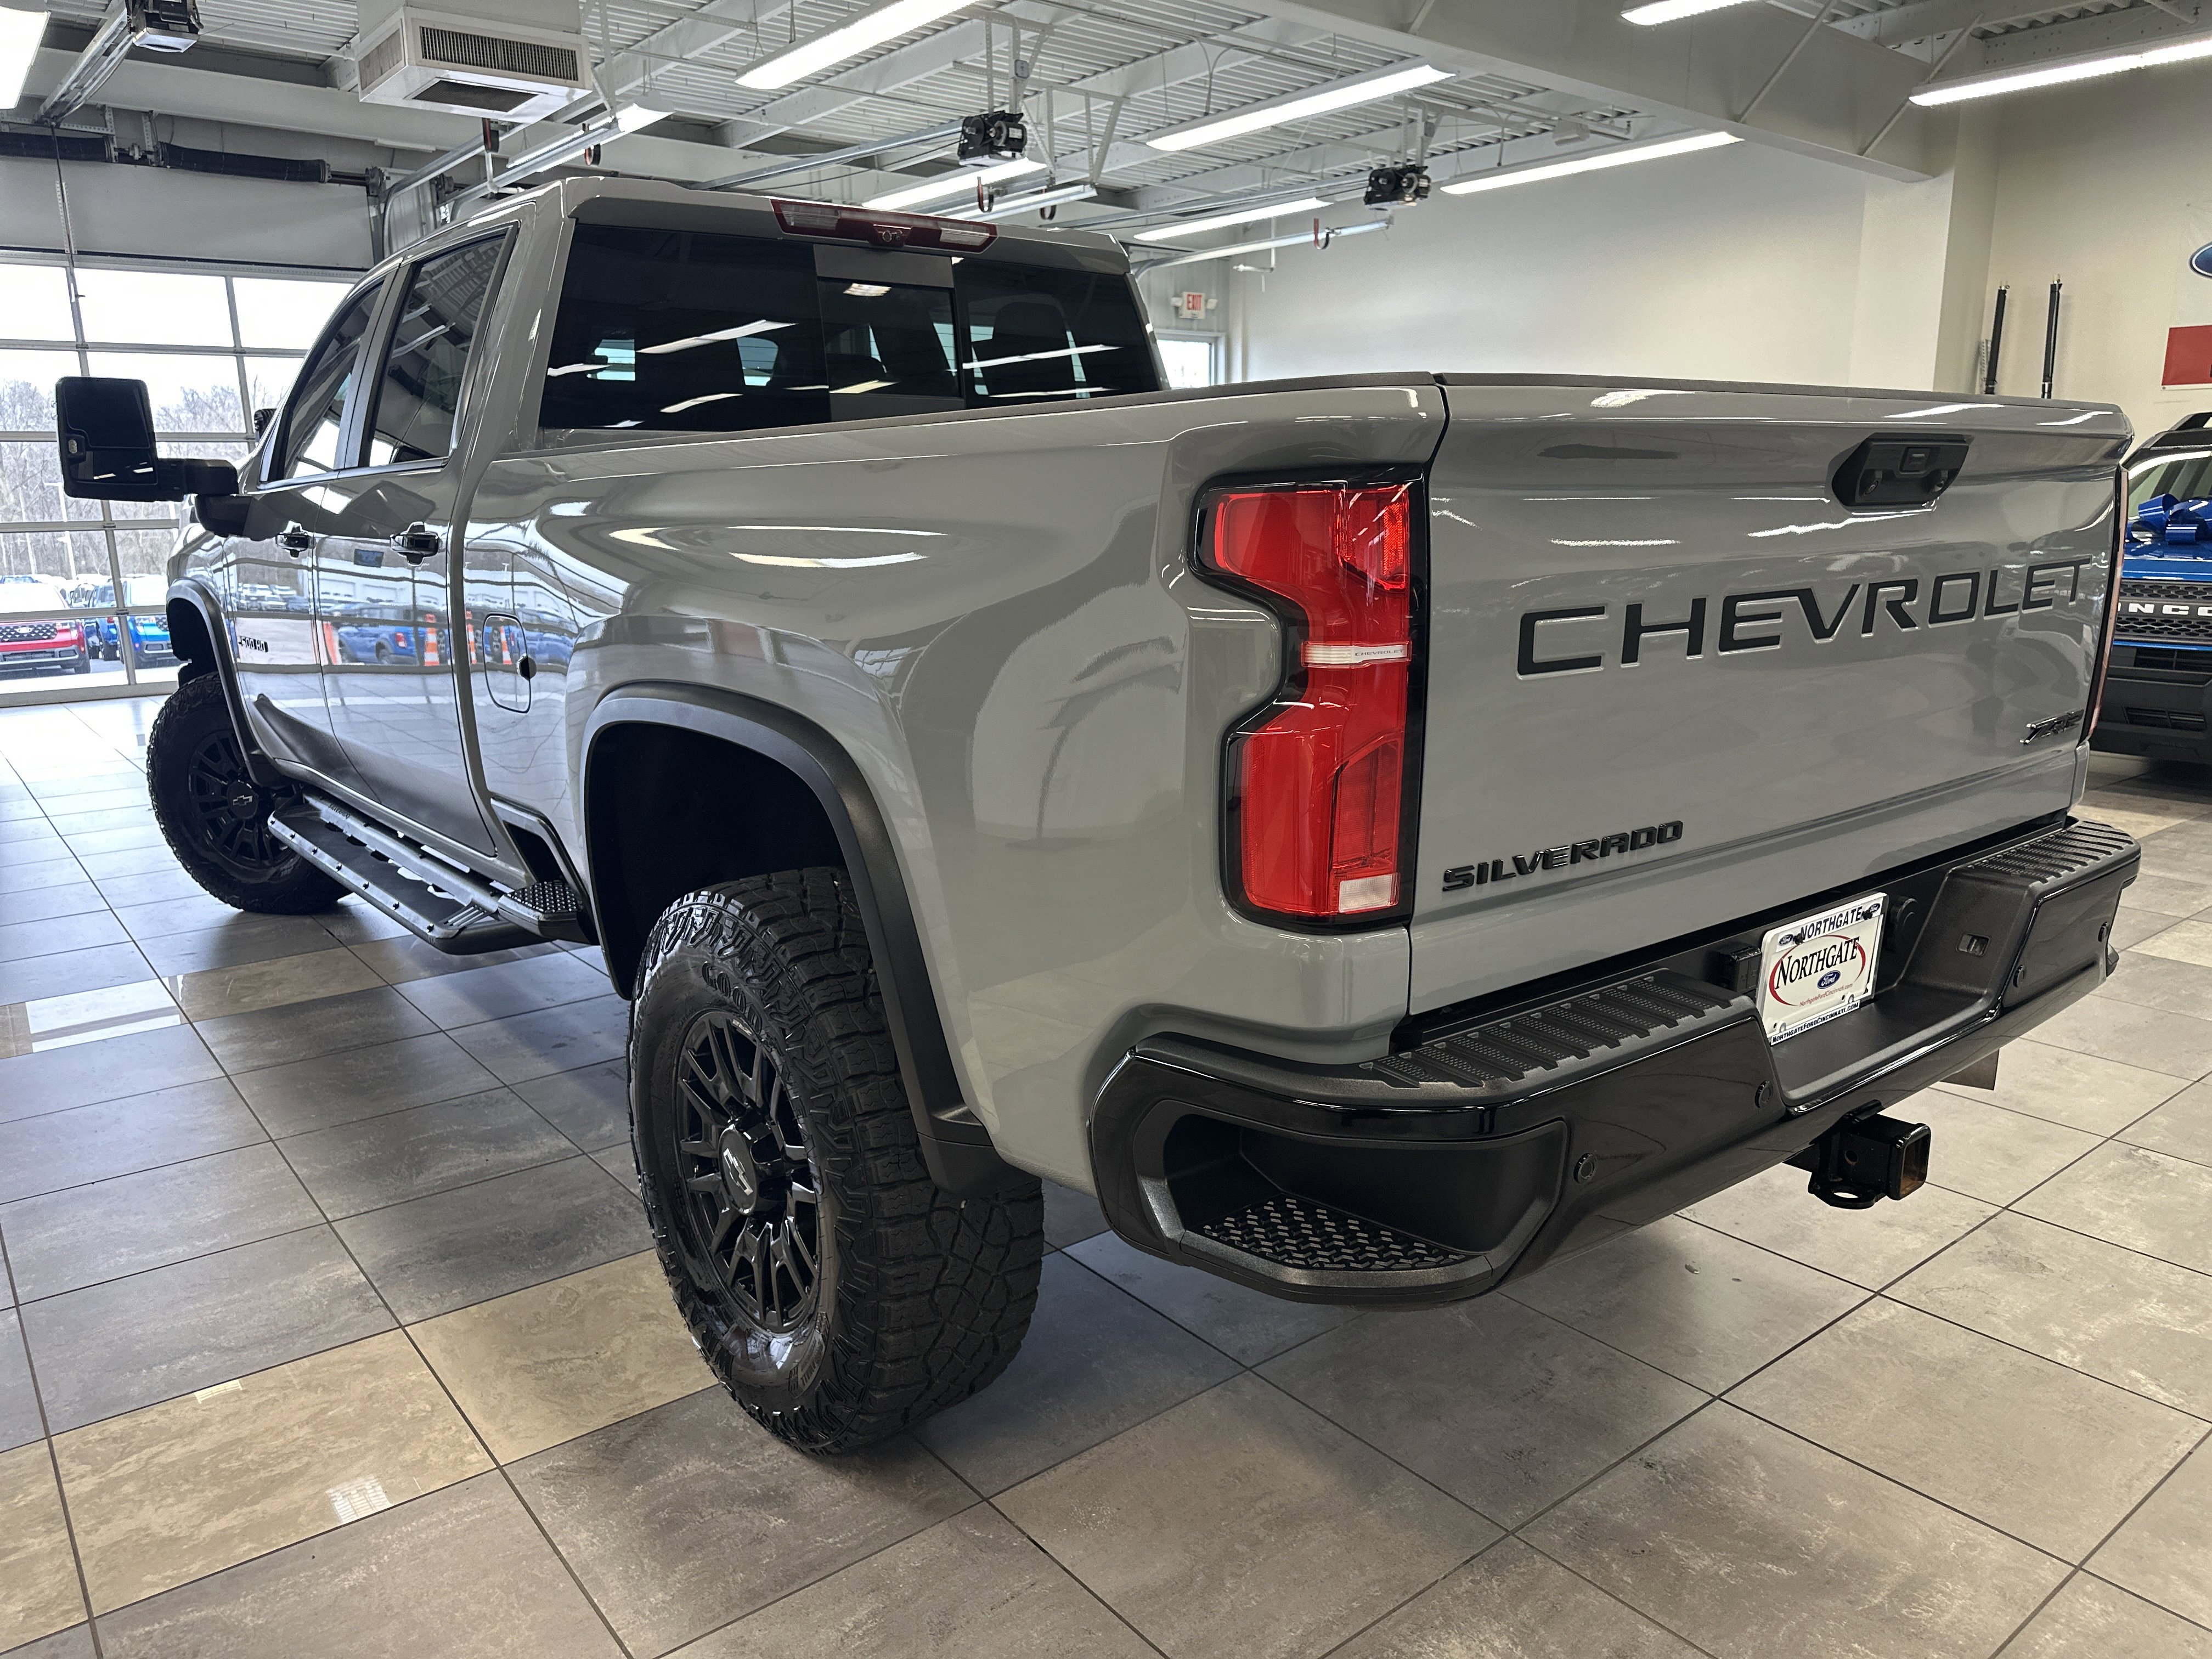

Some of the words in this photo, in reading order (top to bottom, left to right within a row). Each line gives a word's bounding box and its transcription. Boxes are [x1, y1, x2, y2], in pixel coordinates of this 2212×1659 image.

[1517, 555, 2092, 679] CHEVROLET
[1442, 820, 1683, 891] SILVERADO
[1800, 906, 1863, 941] NORTHGATE
[1820, 973, 1838, 987] Ford
